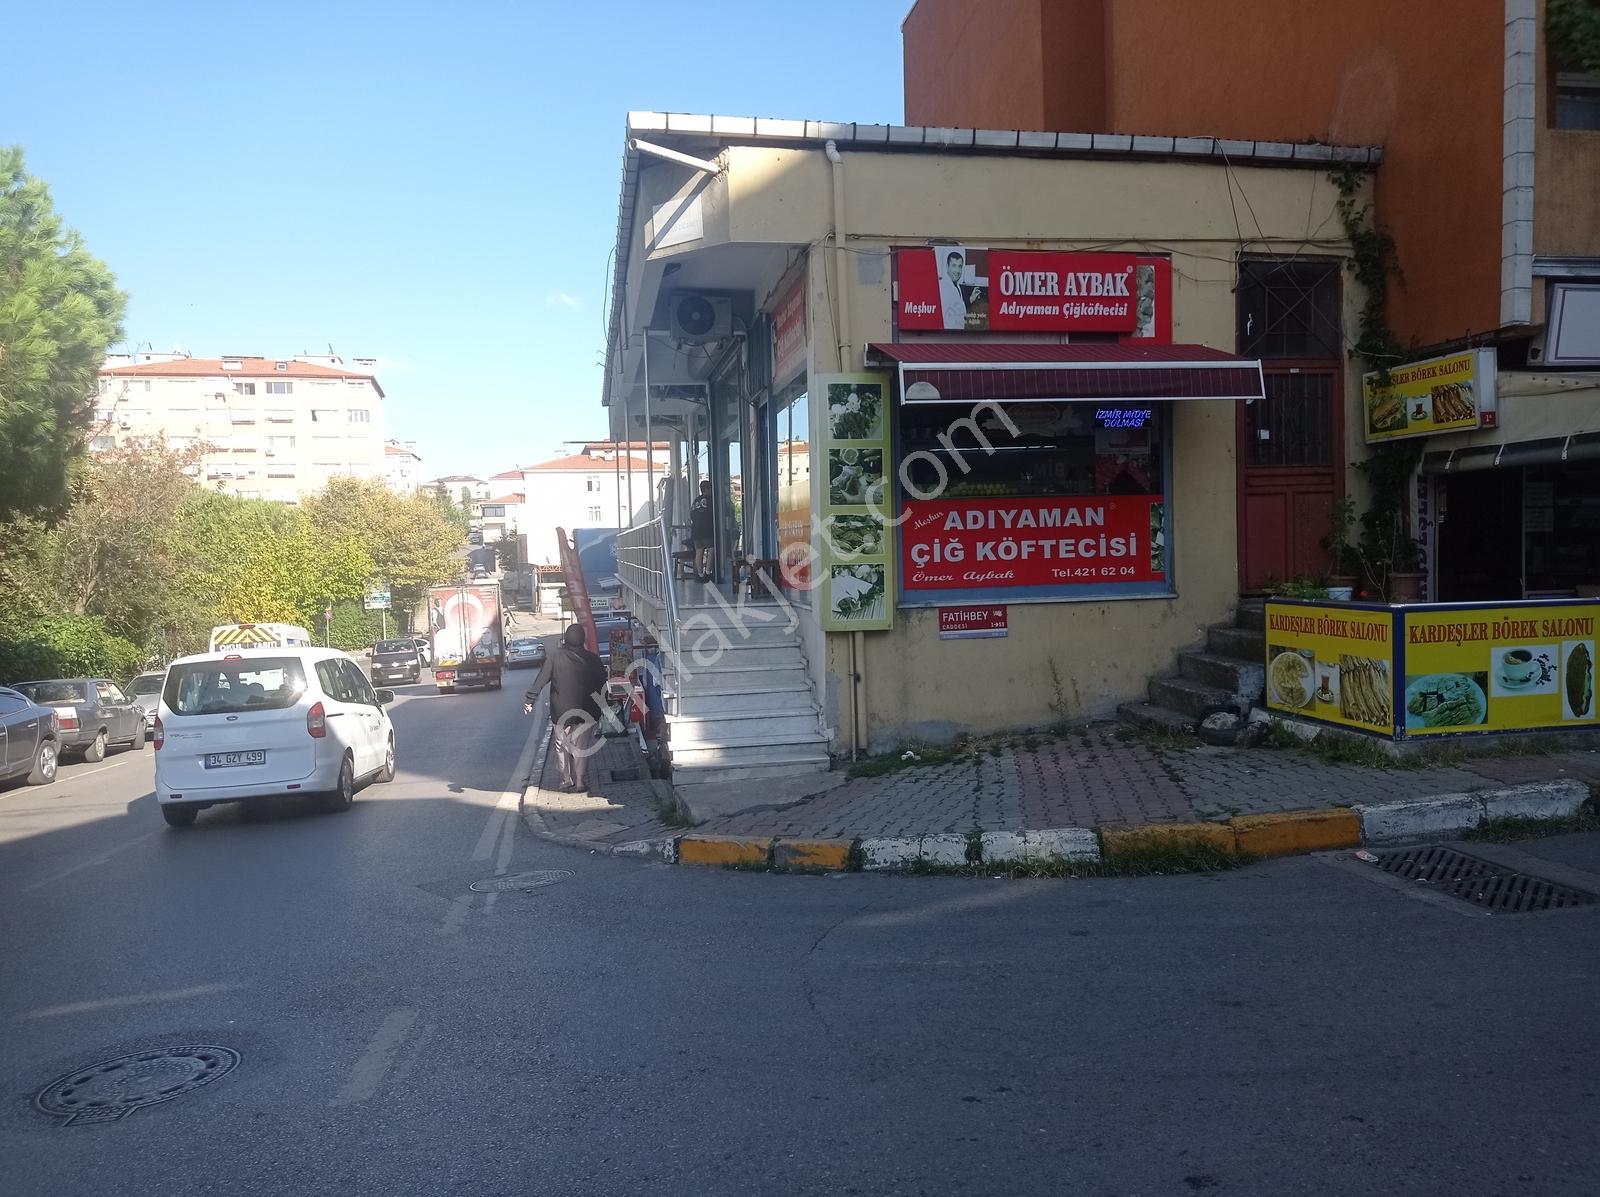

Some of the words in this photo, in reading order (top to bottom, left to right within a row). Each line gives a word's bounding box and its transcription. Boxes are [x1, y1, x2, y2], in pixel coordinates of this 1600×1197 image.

[999, 265, 1060, 297] ÖMER
[1064, 270, 1130, 297] AYBAK
[904, 301, 937, 319] Meşhur
[999, 302, 1060, 317] Adıyaman
[1062, 301, 1128, 320] Çiğköftecisi
[1411, 366, 1438, 382] BÖREK
[1439, 359, 1470, 377] SALONU
[1095, 407, 1121, 420] İZMİR
[1103, 417, 1144, 428] DOLMASI
[913, 511, 944, 531] Meşhur
[943, 507, 1105, 530] ADIYAMAN
[910, 538, 965, 568] ÇİĞ
[976, 532, 1137, 561] KÖFTECİSİ
[911, 572, 955, 582] Ömer
[962, 570, 1015, 582] Aybak
[1101, 567, 1115, 576] 62
[1120, 566, 1135, 575] 04
[942, 610, 988, 622] FATİHBEY
[1269, 614, 1315, 637] KARDEŞLER
[1316, 614, 1349, 637] BÖREK
[1349, 621, 1389, 643] SALONU
[1408, 622, 1488, 647] KARDEŞLER
[1492, 616, 1539, 640] BÖREK
[1541, 617, 1595, 637] SALONU
[211, 755, 222, 765] 34
[226, 753, 242, 763] GZY
[246, 751, 263, 762] 499
